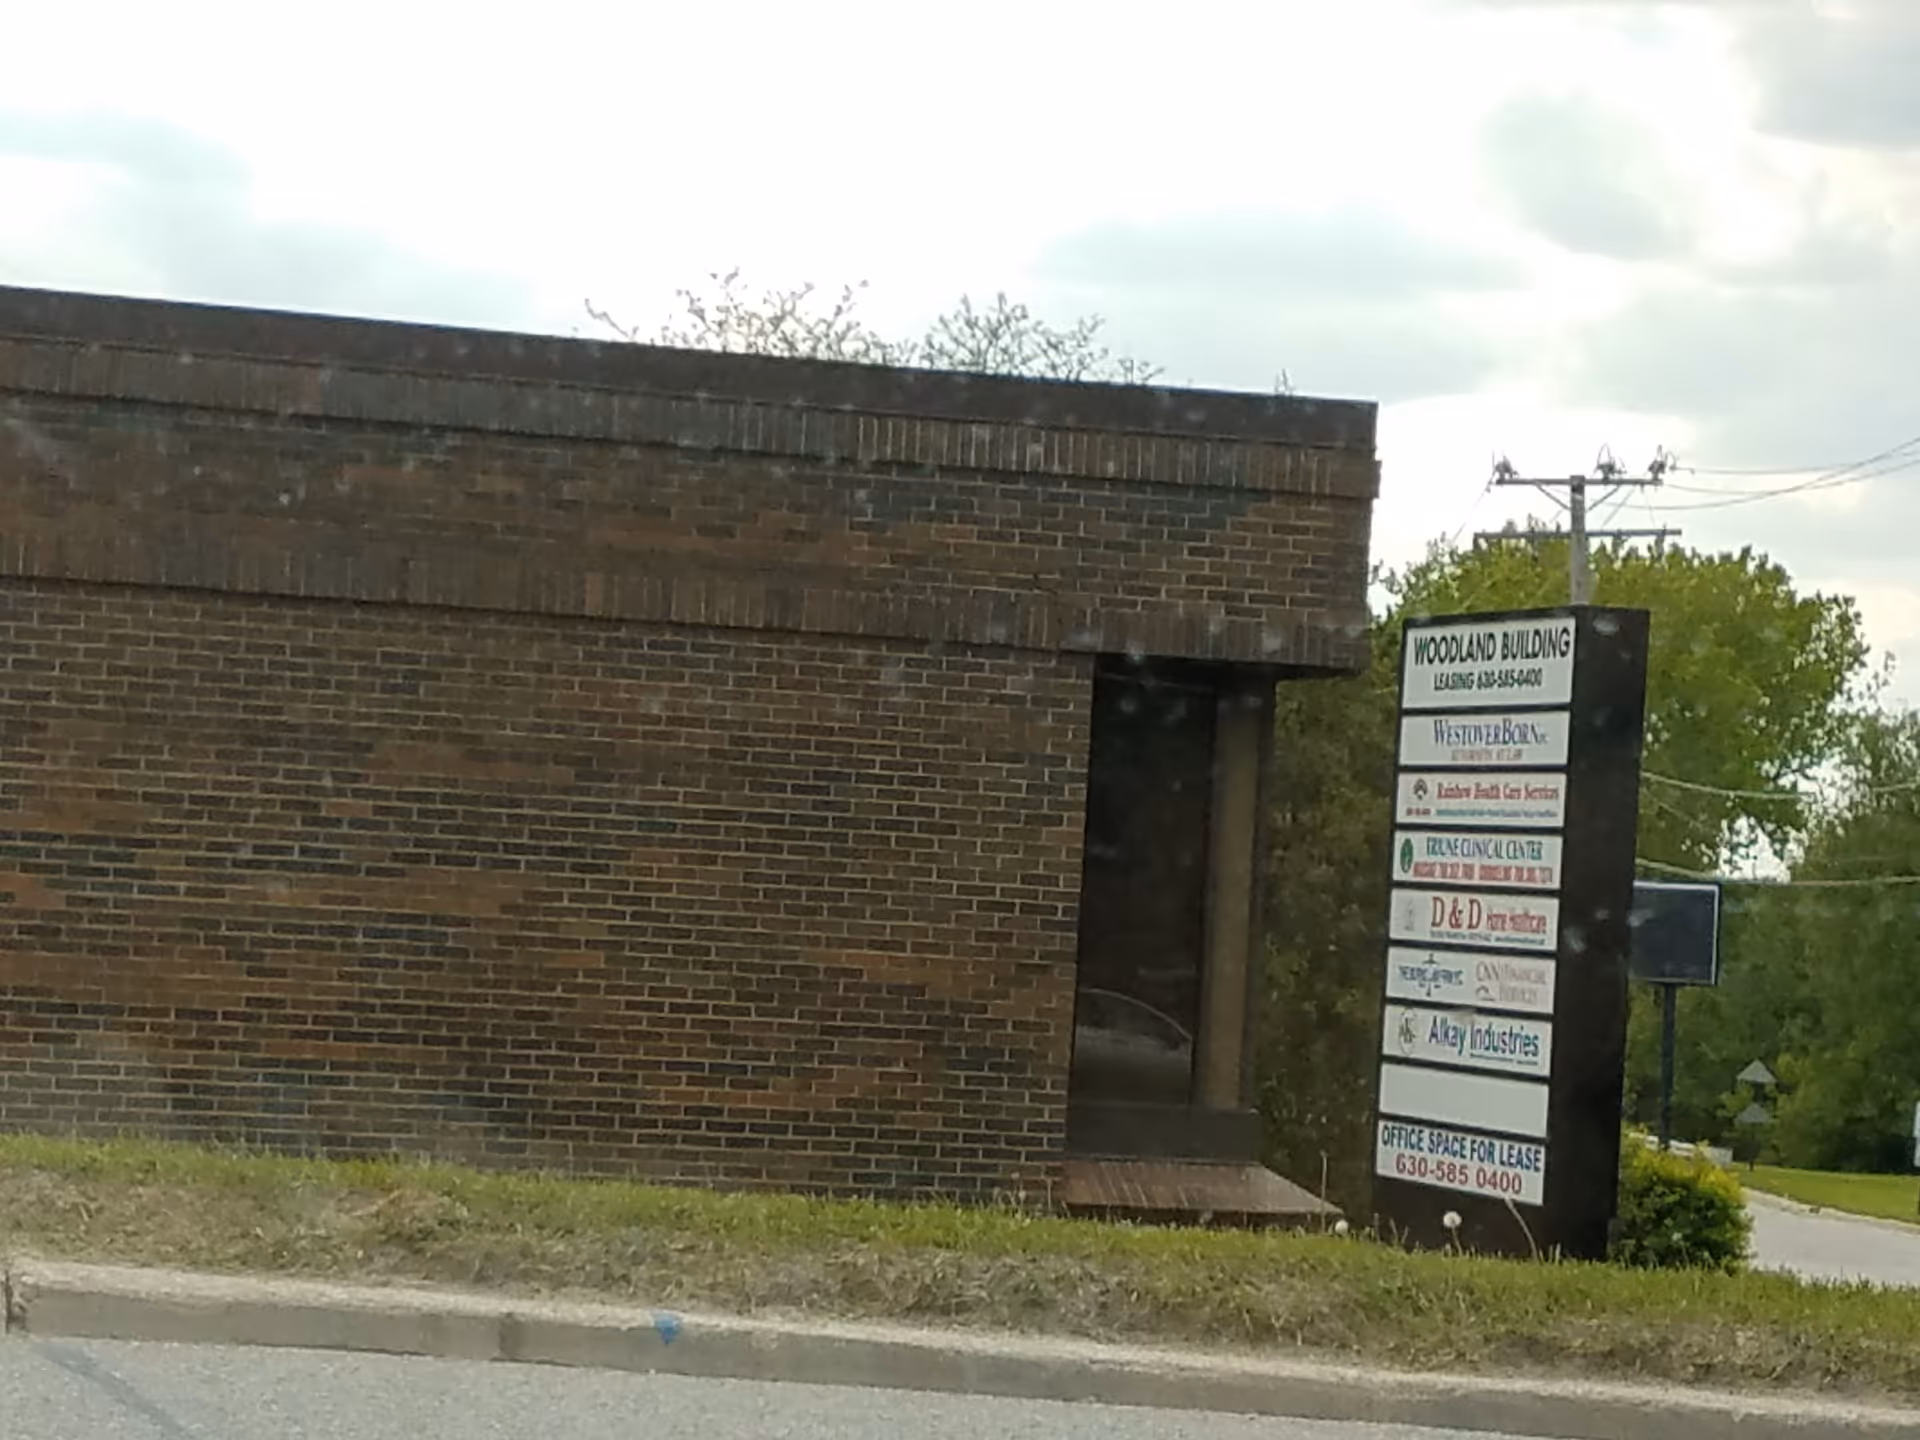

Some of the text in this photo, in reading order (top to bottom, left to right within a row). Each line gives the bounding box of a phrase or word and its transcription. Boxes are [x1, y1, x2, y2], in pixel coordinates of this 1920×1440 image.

[1414, 627, 1570, 665] WOODLAND BUILDING
[1434, 672, 1475, 691] LEASING
[1461, 837, 1504, 859] CLINICAL
[1506, 840, 1543, 861] CENTER
[1431, 896, 1445, 927] D
[1449, 897, 1463, 929] &
[1468, 898, 1482, 929] D
[1428, 1016, 1539, 1057] Alkay Industries
[1381, 1124, 1541, 1172] OFFICE SPACE FOR LEASE
[1396, 1153, 1522, 1195] 630-585 0400
